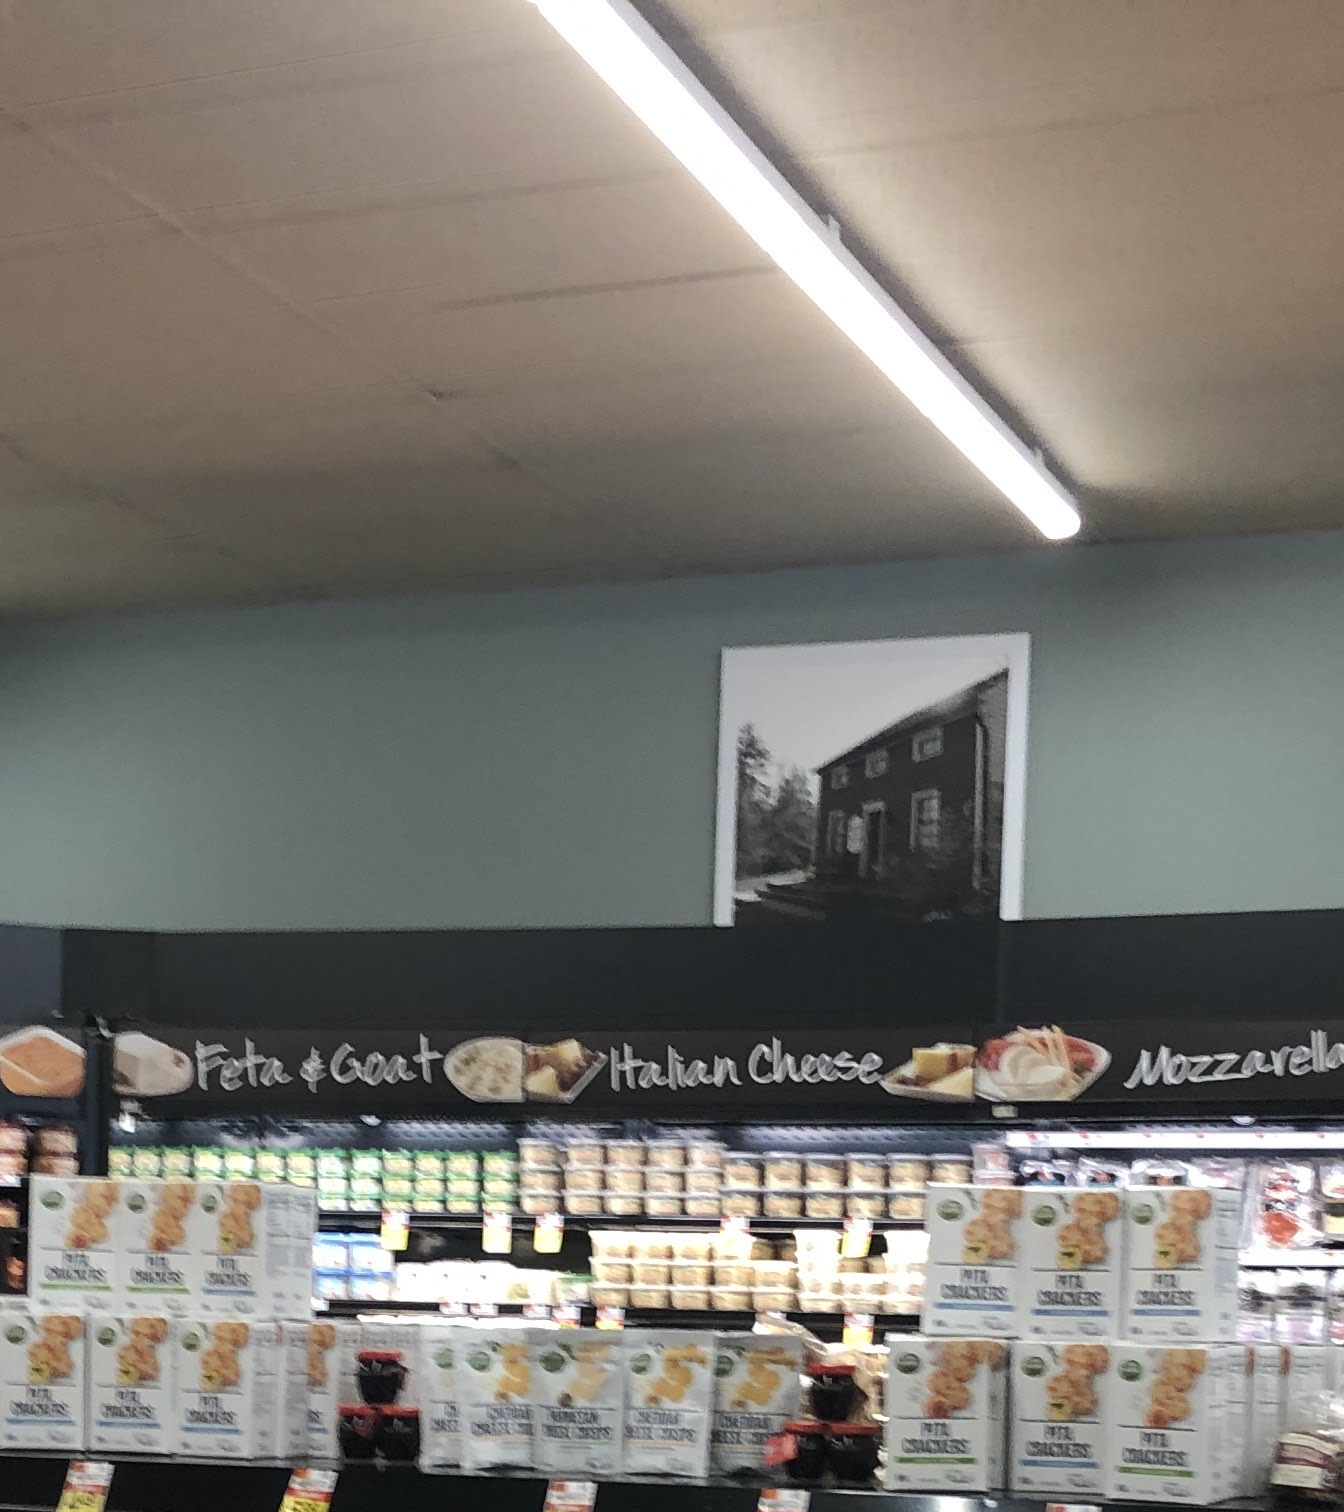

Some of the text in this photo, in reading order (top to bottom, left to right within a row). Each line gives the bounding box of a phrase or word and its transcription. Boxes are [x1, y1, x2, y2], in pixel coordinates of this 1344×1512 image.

[195, 1037, 293, 1091] Feta
[330, 1032, 444, 1087] Goat
[610, 1036, 884, 1091] Italian Cheese
